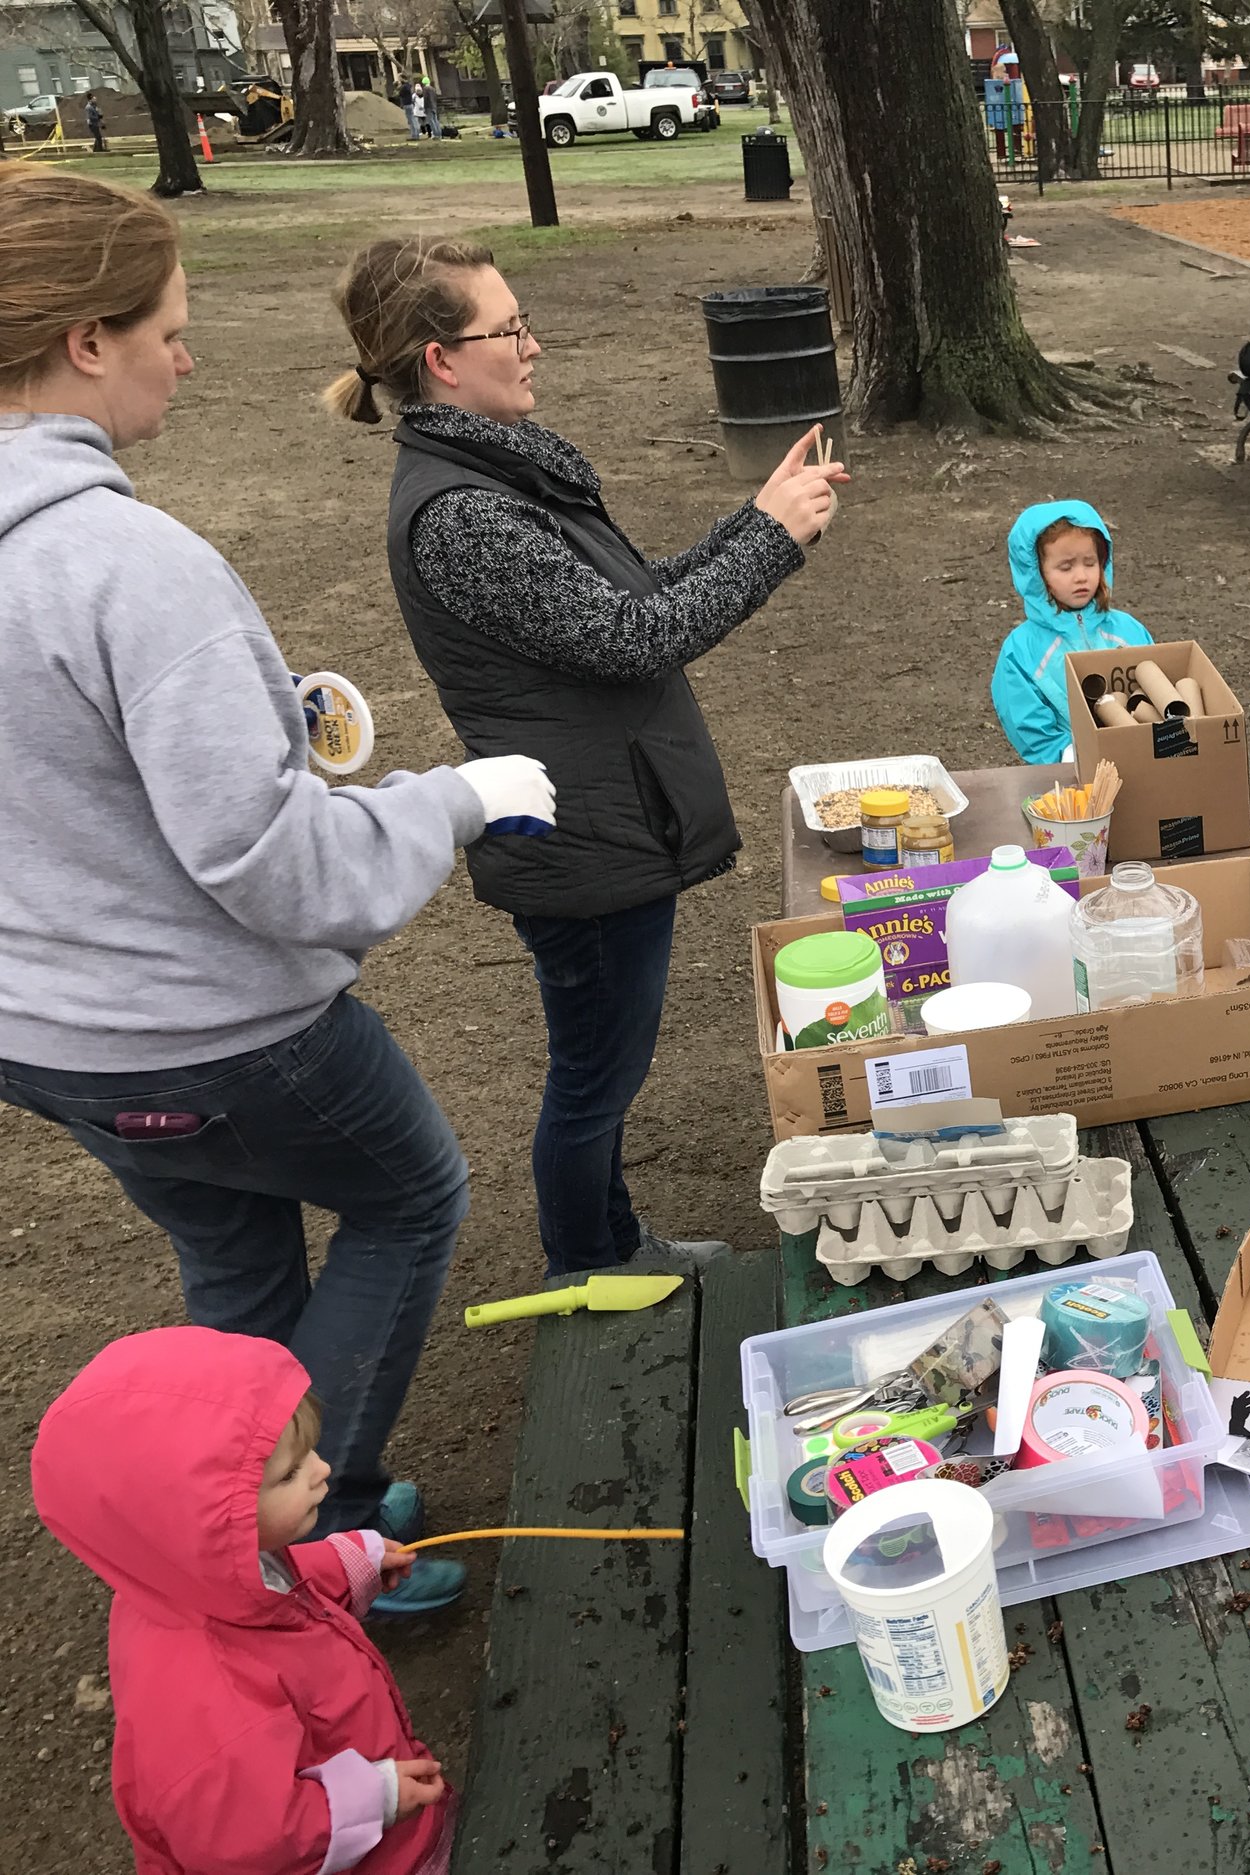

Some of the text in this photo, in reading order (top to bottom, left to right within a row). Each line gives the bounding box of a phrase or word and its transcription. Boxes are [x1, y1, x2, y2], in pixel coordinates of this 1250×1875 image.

[865, 874, 914, 894] Annie's
[895, 893, 924, 904] Made
[926, 889, 951, 899] with
[877, 934, 917, 944] OMEGROWN
[902, 970, 951, 992] 6-PAC
[1046, 1034, 1109, 1049] Safety Requirements
[1052, 1048, 1071, 1058] ASTM
[1080, 1043, 1109, 1053] Conforms
[1010, 1054, 1030, 1063] CPSC
[1232, 1052, 1241, 1060] IN
[1085, 1067, 1111, 1077] Republic
[1229, 1070, 1248, 1079] Long
[1055, 1074, 1076, 1082] Ireland
[1185, 1079, 1198, 1087] CA
[1200, 1074, 1227, 1086] Beach,
[1021, 1087, 1041, 1096] Dublin
[1076, 1087, 1095, 1097] Street
[1158, 1082, 1183, 1092] 90802
[1087, 1092, 1113, 1104] Imported
[1040, 1100, 1072, 1109] Distributed
[1066, 1301, 1106, 1318] Scotch
[1048, 1387, 1070, 1399] DUCK
[1100, 1415, 1118, 1430] DUCK
[837, 1472, 864, 1502] Scotch
